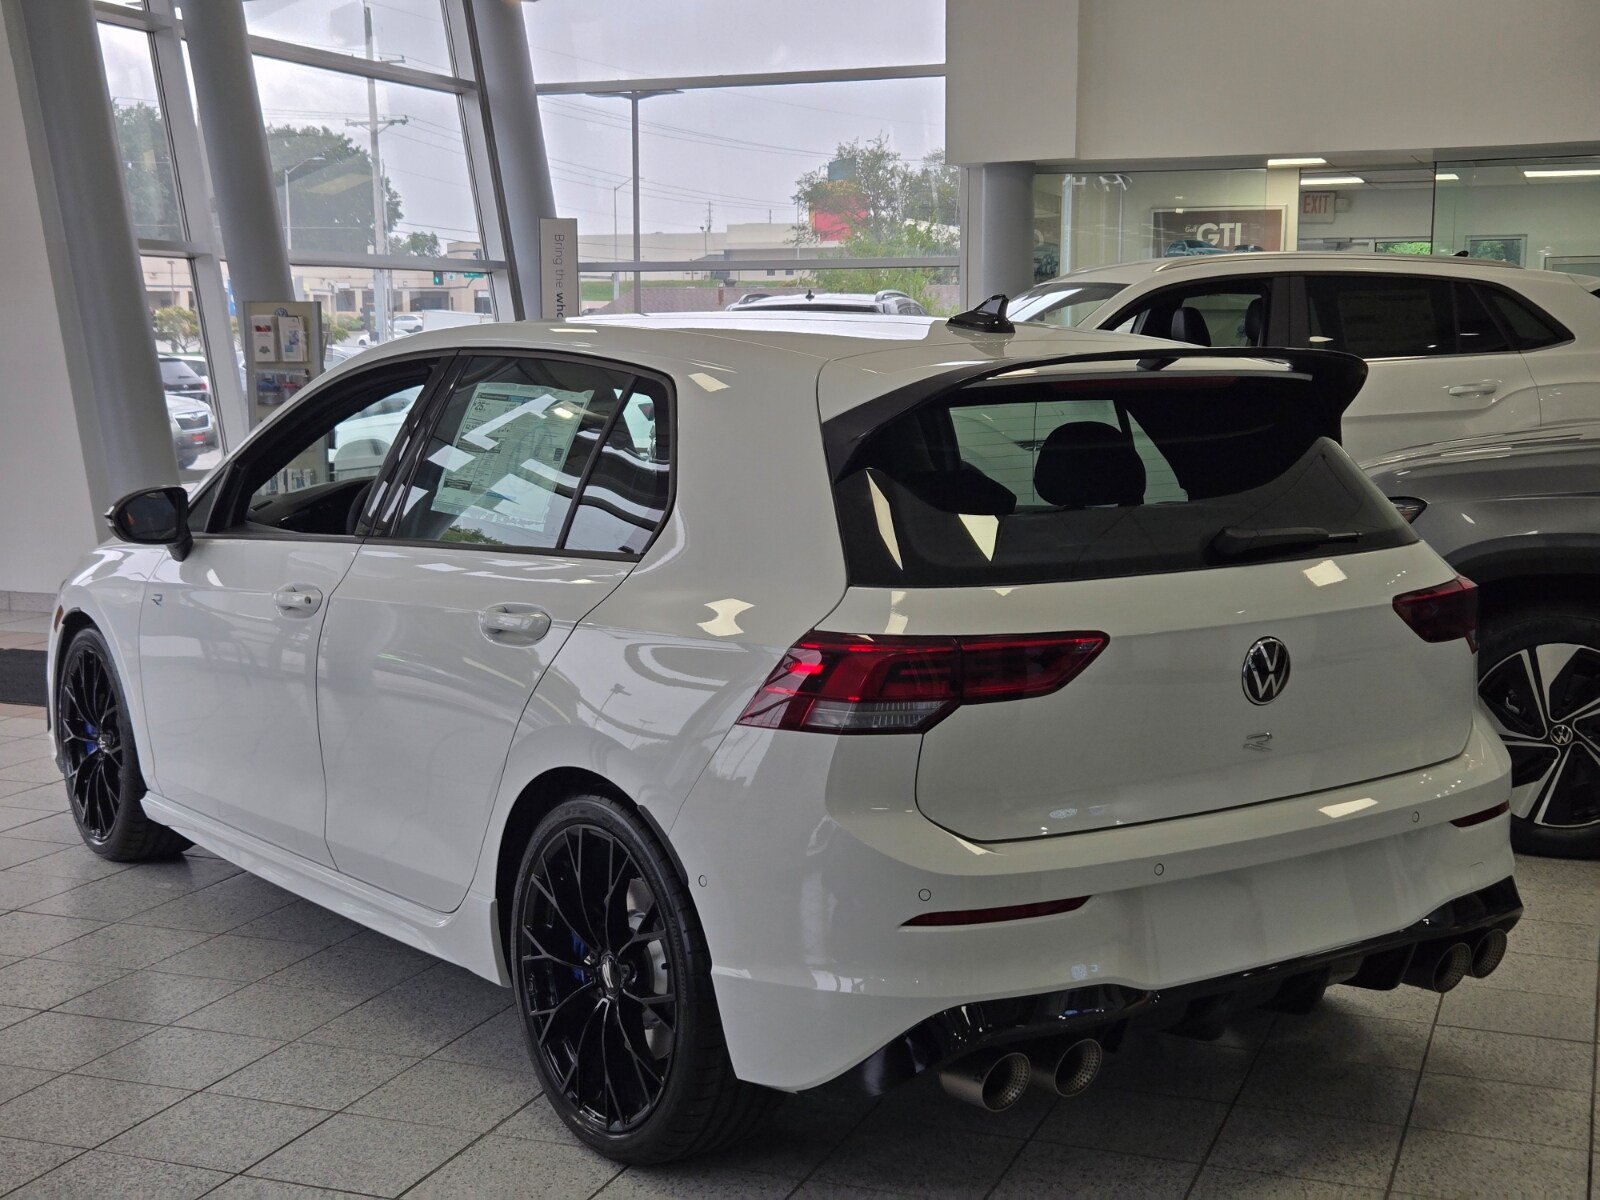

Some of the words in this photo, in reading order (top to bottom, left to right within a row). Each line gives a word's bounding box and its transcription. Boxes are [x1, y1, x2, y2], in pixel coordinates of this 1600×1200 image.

[1303, 194, 1330, 214] EXIT
[1196, 222, 1242, 247] GTI
[553, 234, 565, 265] Bring
[555, 269, 566, 288] the
